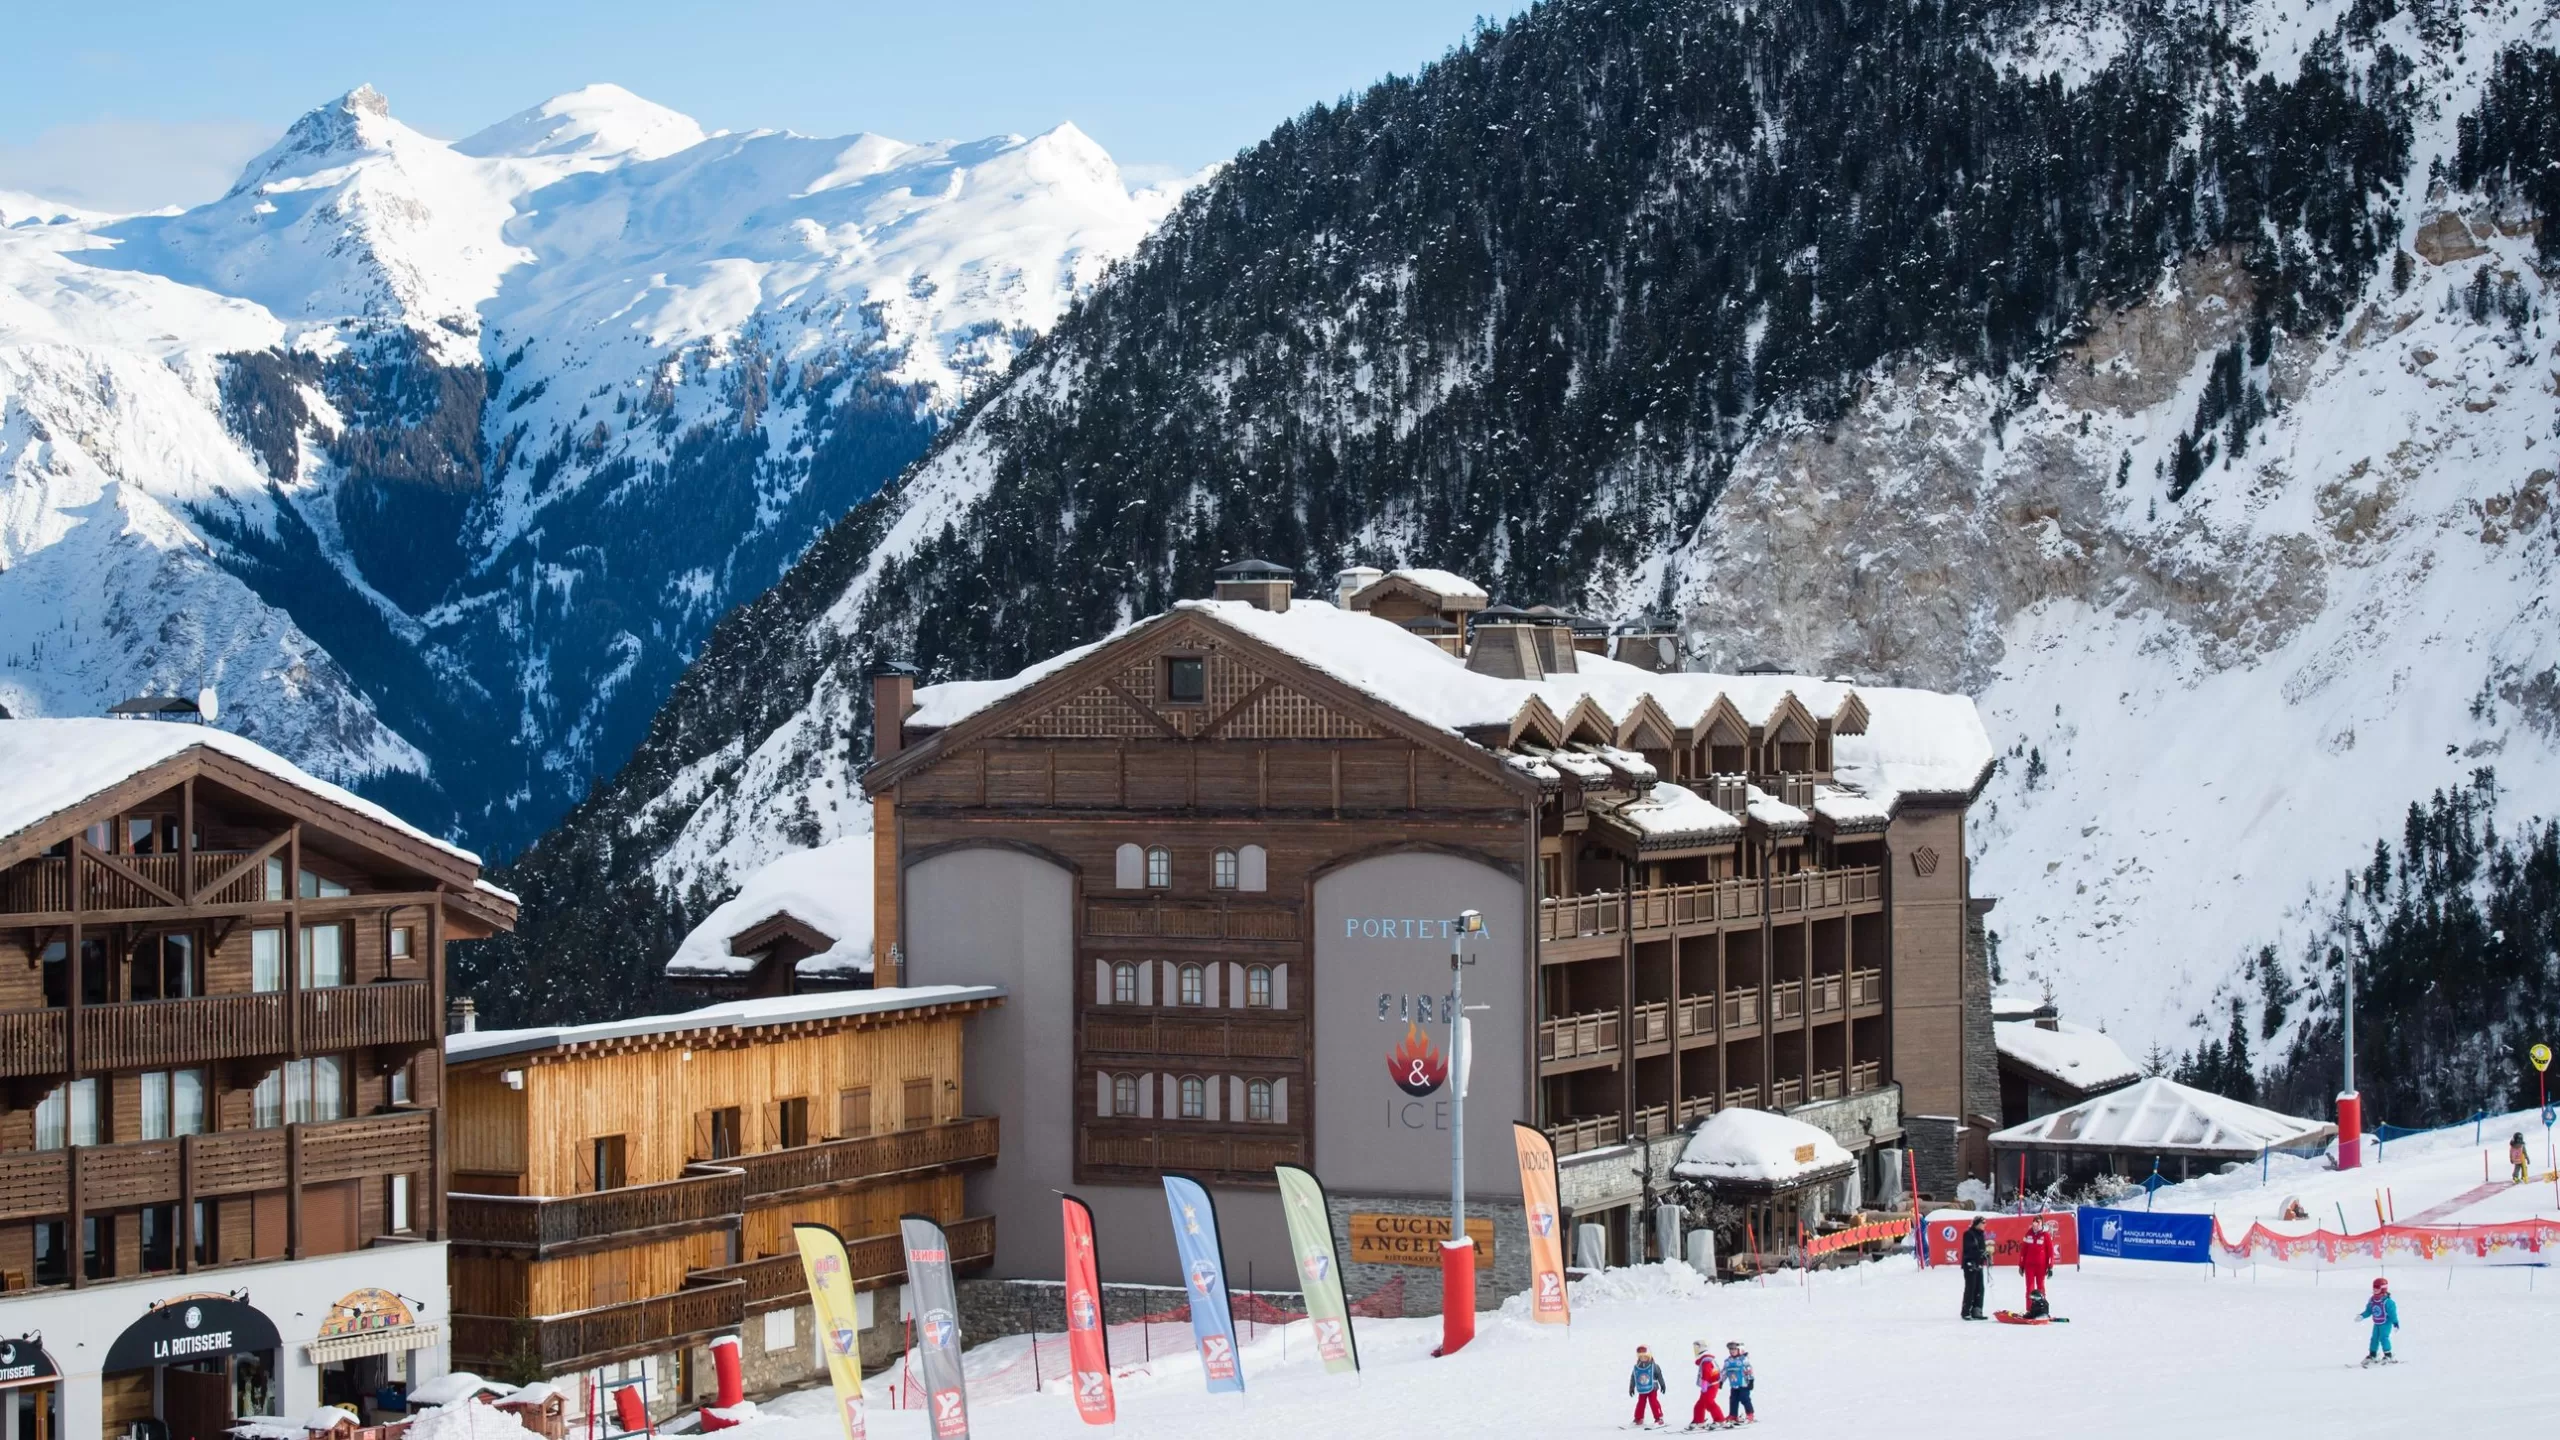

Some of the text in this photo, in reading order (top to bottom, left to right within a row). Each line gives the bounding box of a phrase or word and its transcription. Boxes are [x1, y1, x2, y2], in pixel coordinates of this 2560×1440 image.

[1408, 1058, 1431, 1087] &
[1387, 1099, 1448, 1130] ICE
[1376, 1217, 1451, 1234] CUCIN
[1360, 1237, 1484, 1255] ANGELA
[2123, 1237, 2154, 1246] AUVERGNE
[2177, 1239, 2196, 1247] ALPES
[154, 1331, 233, 1359] LA ROTISSERIE
[0, 1364, 36, 1381] OTISSERIE
